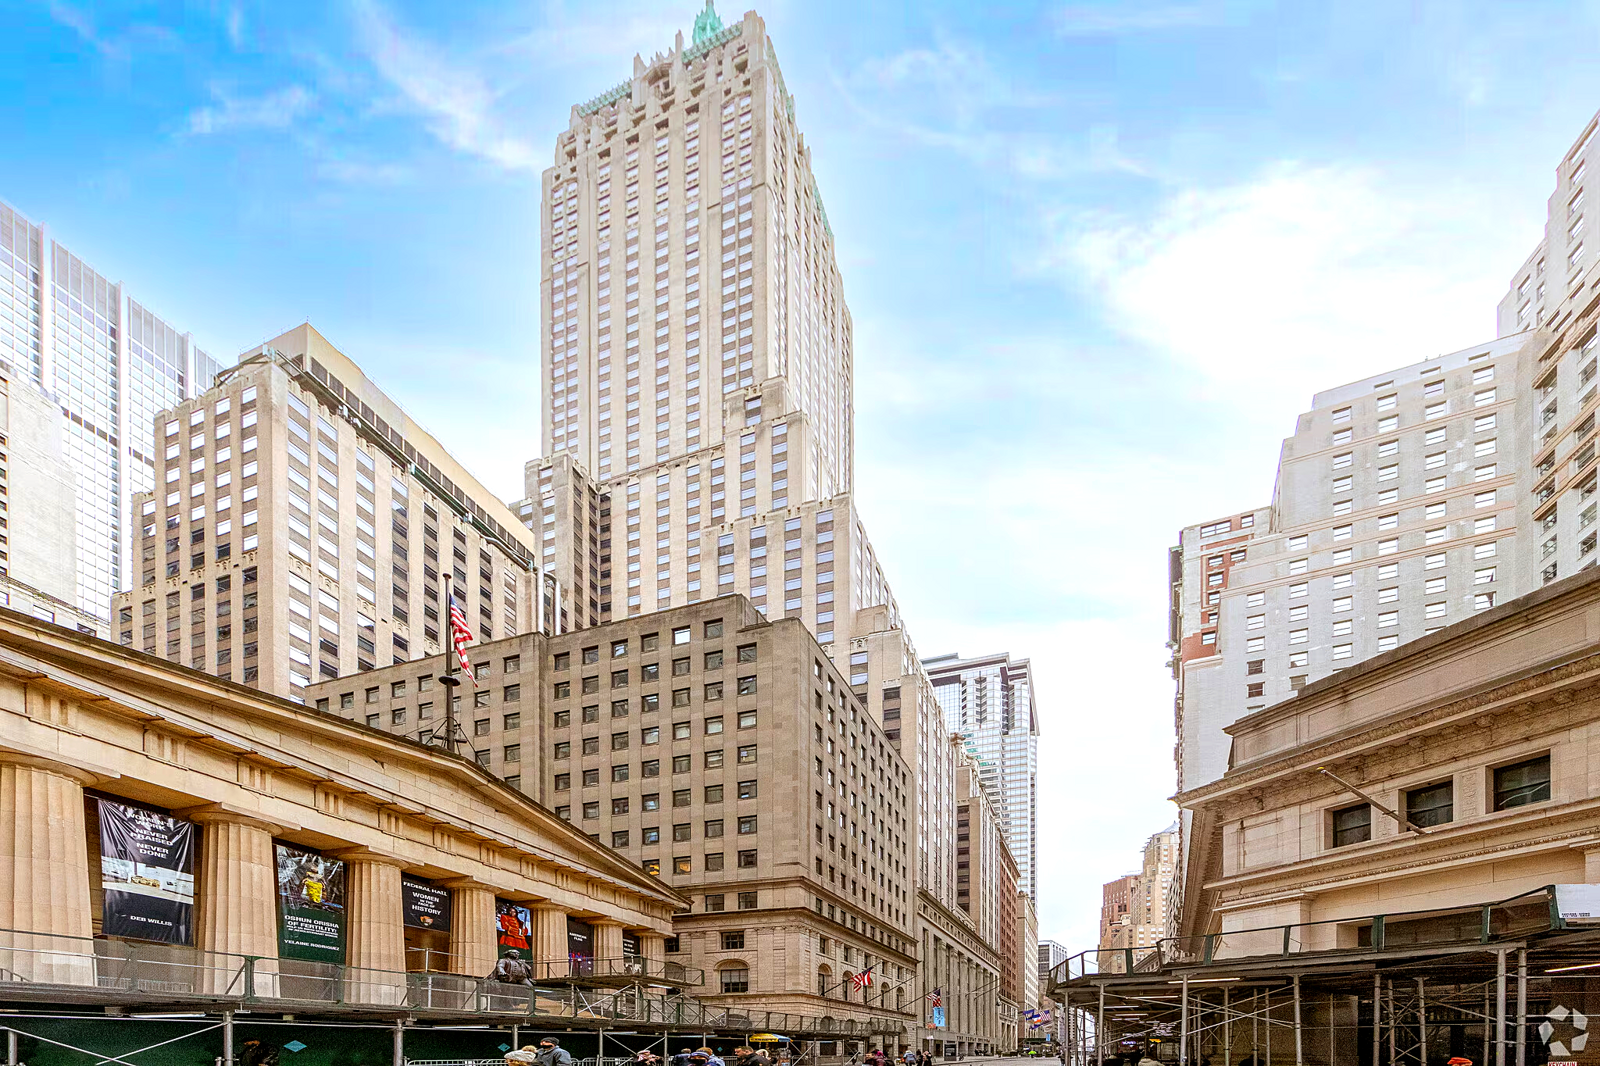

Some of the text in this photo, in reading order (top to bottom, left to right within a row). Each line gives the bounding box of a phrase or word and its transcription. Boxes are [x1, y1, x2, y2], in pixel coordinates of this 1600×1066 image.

[135, 820, 166, 831] WORK
[131, 833, 173, 846] PRAISED
[136, 828, 168, 840] NEVER
[137, 843, 169, 854] NEVER
[140, 849, 167, 859] DONE
[403, 881, 448, 897] FEDERAL HALL
[412, 892, 440, 903] WOMEN
[412, 905, 441, 915] HISTORY
[148, 918, 172, 926] WILLIS
[285, 915, 339, 929] OSHUN ORISHA
